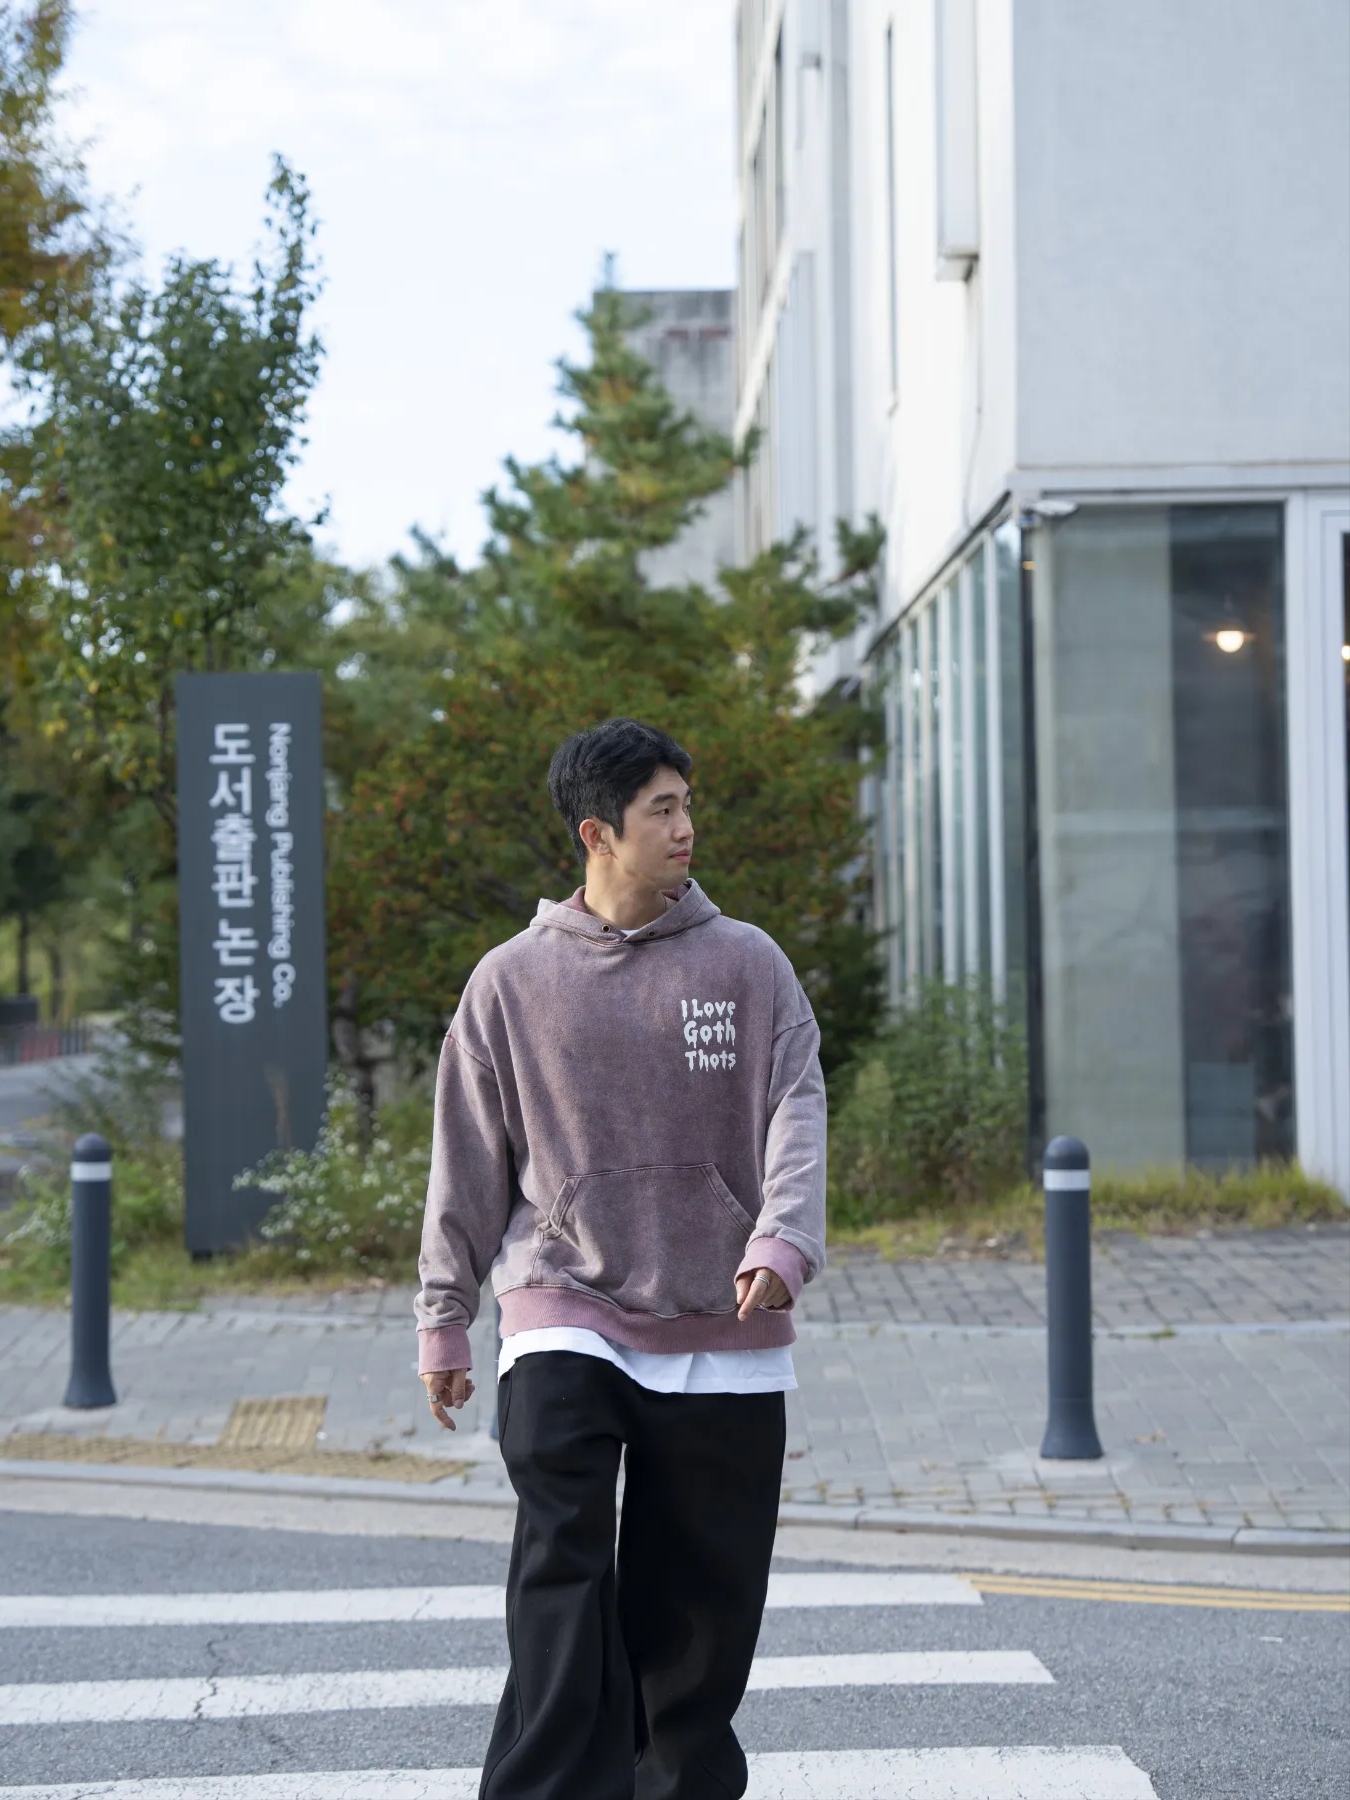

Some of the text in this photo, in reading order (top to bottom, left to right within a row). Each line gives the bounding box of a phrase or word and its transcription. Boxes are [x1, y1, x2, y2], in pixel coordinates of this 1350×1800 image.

[208, 722, 259, 908] 도서출판
[265, 722, 297, 1009] Nonjang Publishing Co.
[681, 998, 736, 1021] I Love
[684, 1018, 736, 1049] Goth
[685, 1048, 736, 1072] Thots
